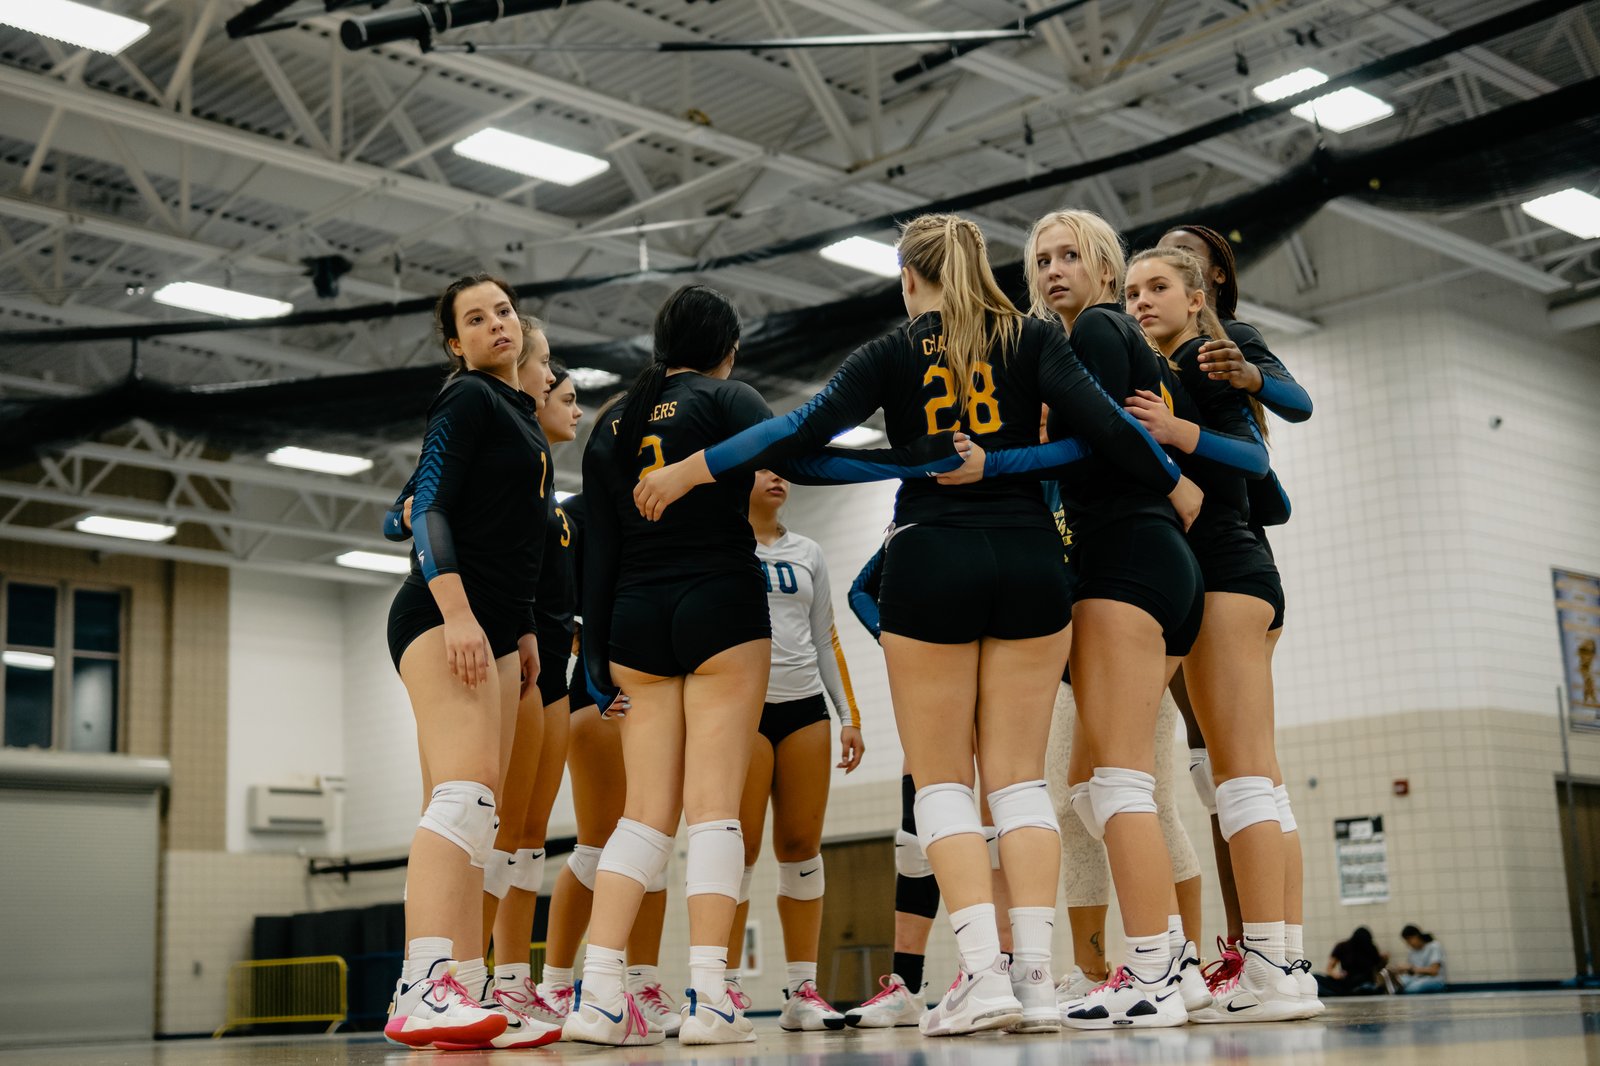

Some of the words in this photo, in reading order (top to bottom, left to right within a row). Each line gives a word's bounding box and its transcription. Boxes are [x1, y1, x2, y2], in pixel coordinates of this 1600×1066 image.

[923, 361, 1003, 434] 28
[638, 434, 665, 481] 2
[555, 507, 571, 547] 3
[760, 560, 799, 594] 10
